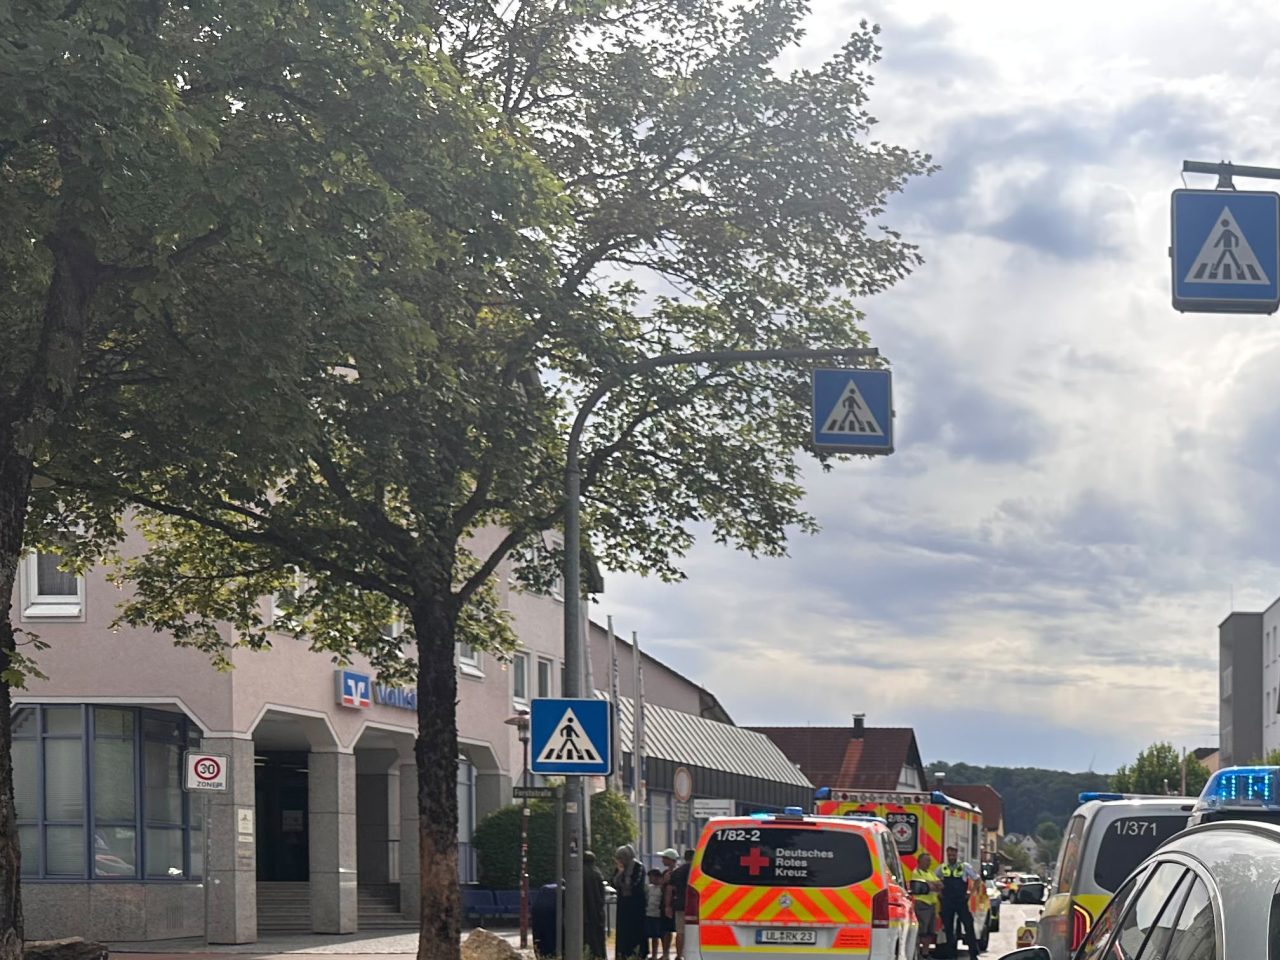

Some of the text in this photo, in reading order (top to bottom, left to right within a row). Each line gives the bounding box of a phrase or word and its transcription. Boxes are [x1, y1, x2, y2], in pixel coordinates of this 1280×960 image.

[199, 763, 216, 775] 30
[1114, 821, 1157, 836] 1/371
[716, 830, 761, 841] 1/82-2
[775, 848, 834, 858] Deutsches
[775, 858, 808, 867] Rotes
[775, 868, 808, 877] Kreuz
[786, 931, 798, 941] RK
[800, 931, 813, 941] 23
